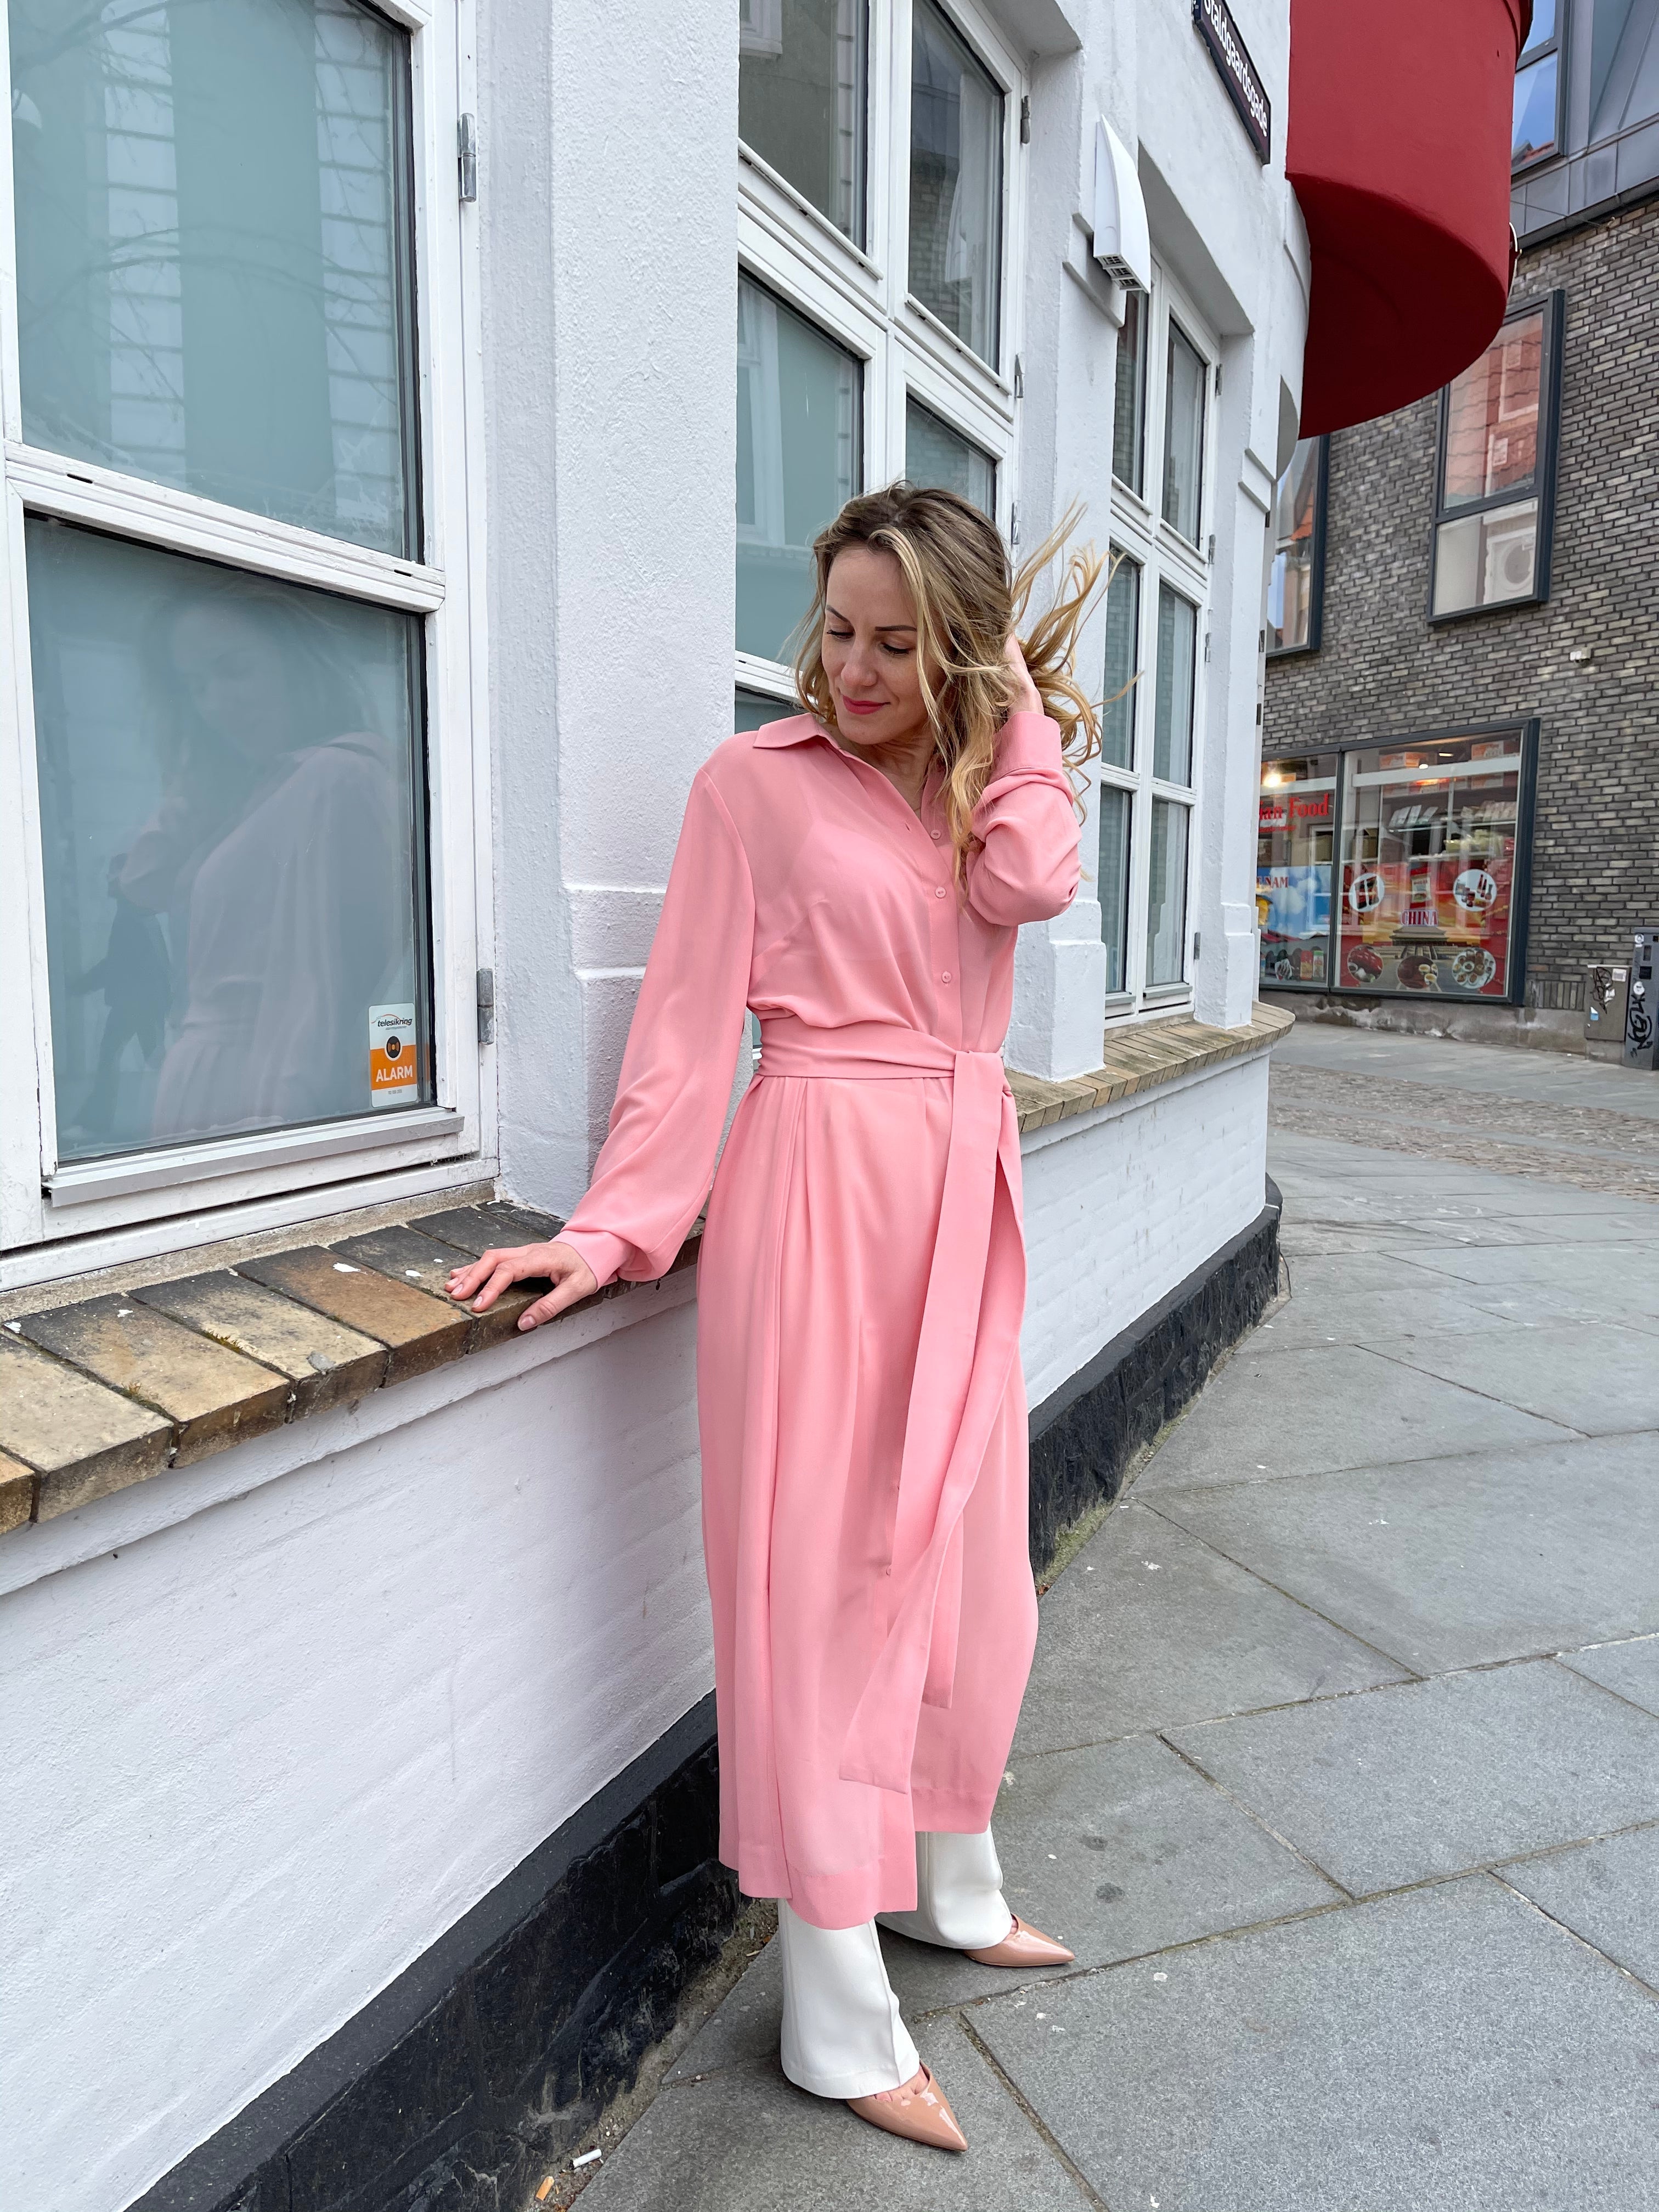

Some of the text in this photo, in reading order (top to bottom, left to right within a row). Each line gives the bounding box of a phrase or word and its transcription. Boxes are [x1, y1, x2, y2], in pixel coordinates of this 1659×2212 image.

[1288, 793, 1329, 818] Food
[1401, 910, 1438, 926] CHINA
[377, 1018, 413, 1027] telesikring
[376, 1065, 413, 1082] ALARM
